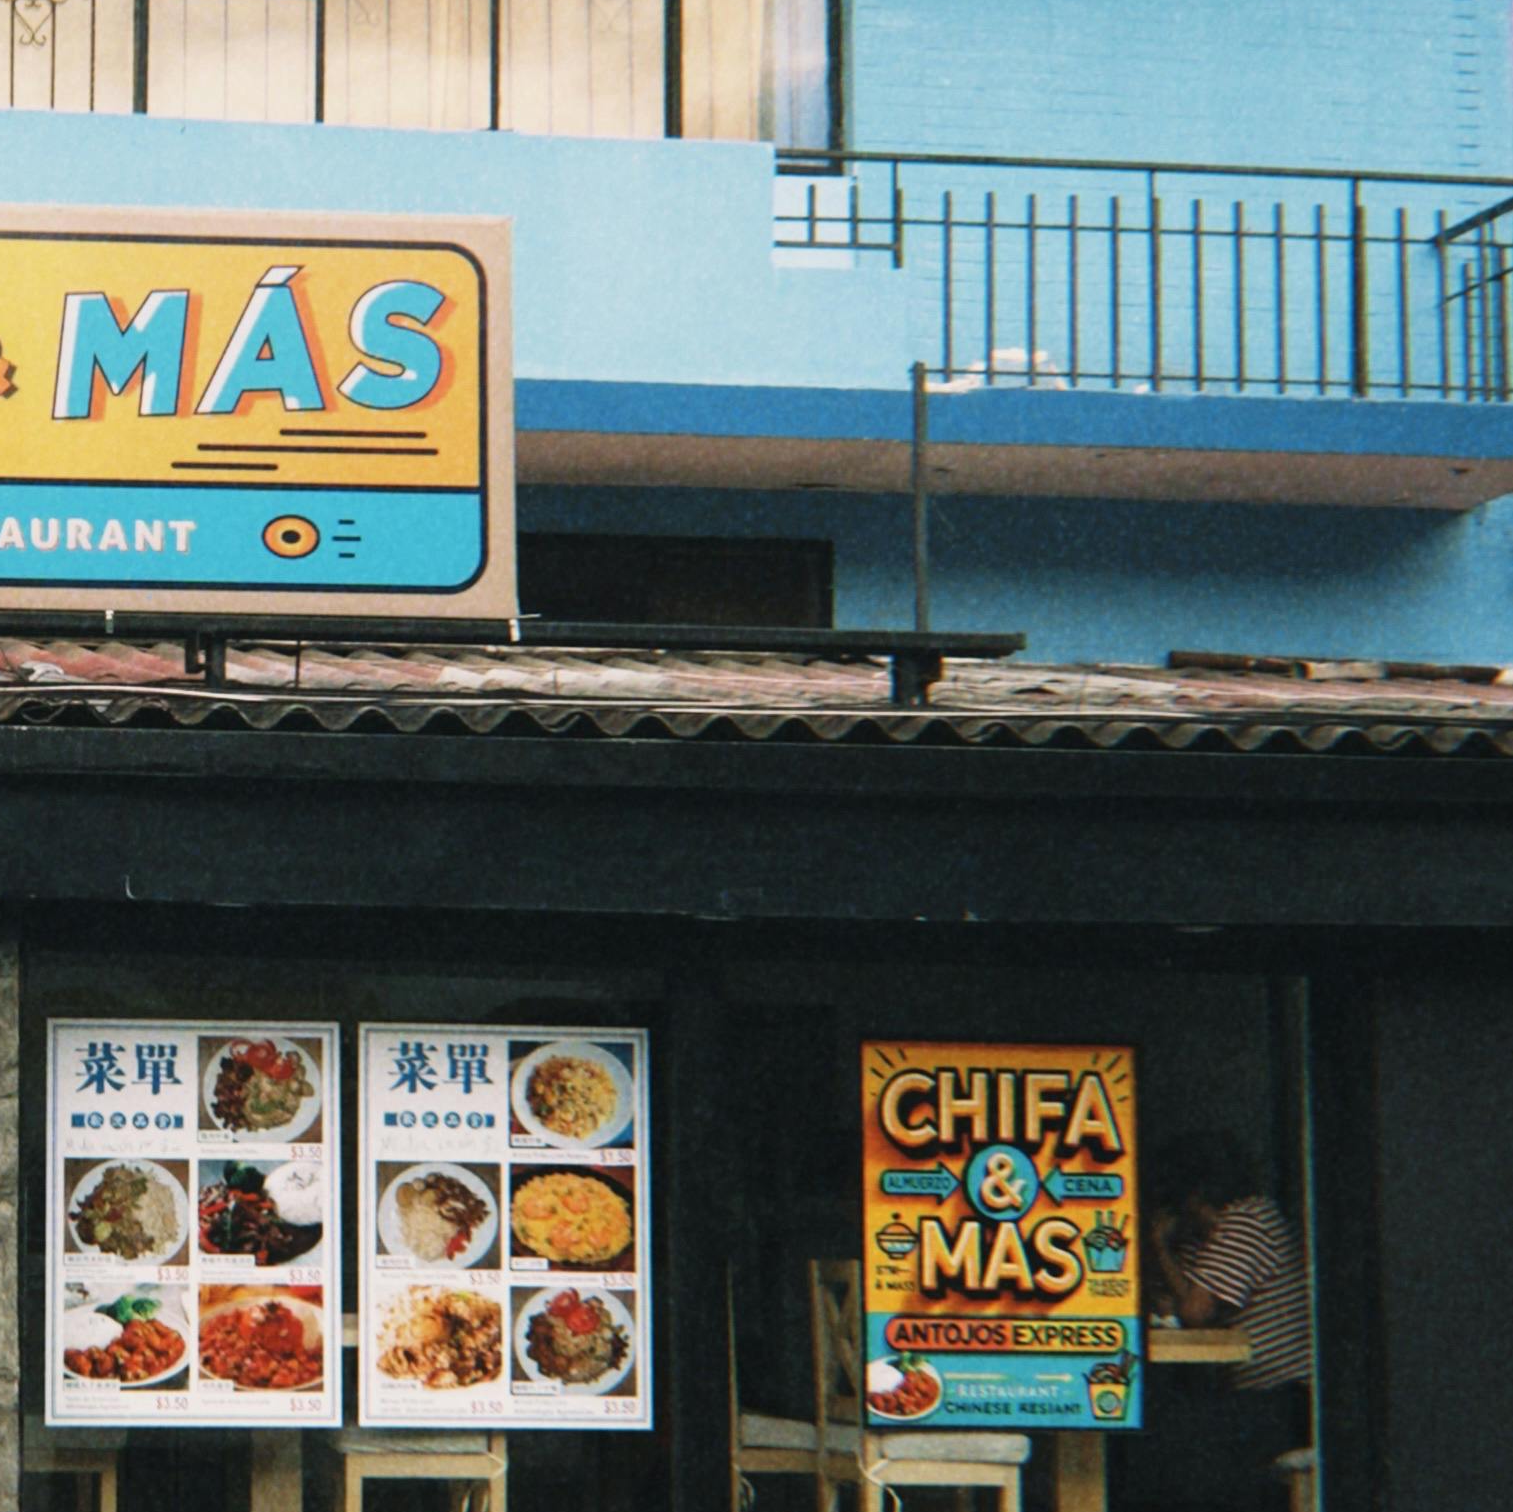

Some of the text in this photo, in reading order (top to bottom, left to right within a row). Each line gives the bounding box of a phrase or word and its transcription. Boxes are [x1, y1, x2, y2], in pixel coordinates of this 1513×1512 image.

[50, 264, 459, 422] MÁS
[75, 1041, 183, 1095] 菜單
[387, 1040, 494, 1094] 菜單
[878, 1067, 1124, 1161] CHIFA
[978, 1151, 1028, 1211] &
[1062, 1178, 1115, 1193] CENA
[893, 1323, 1118, 1347] ANTOJOS EXPRESS
